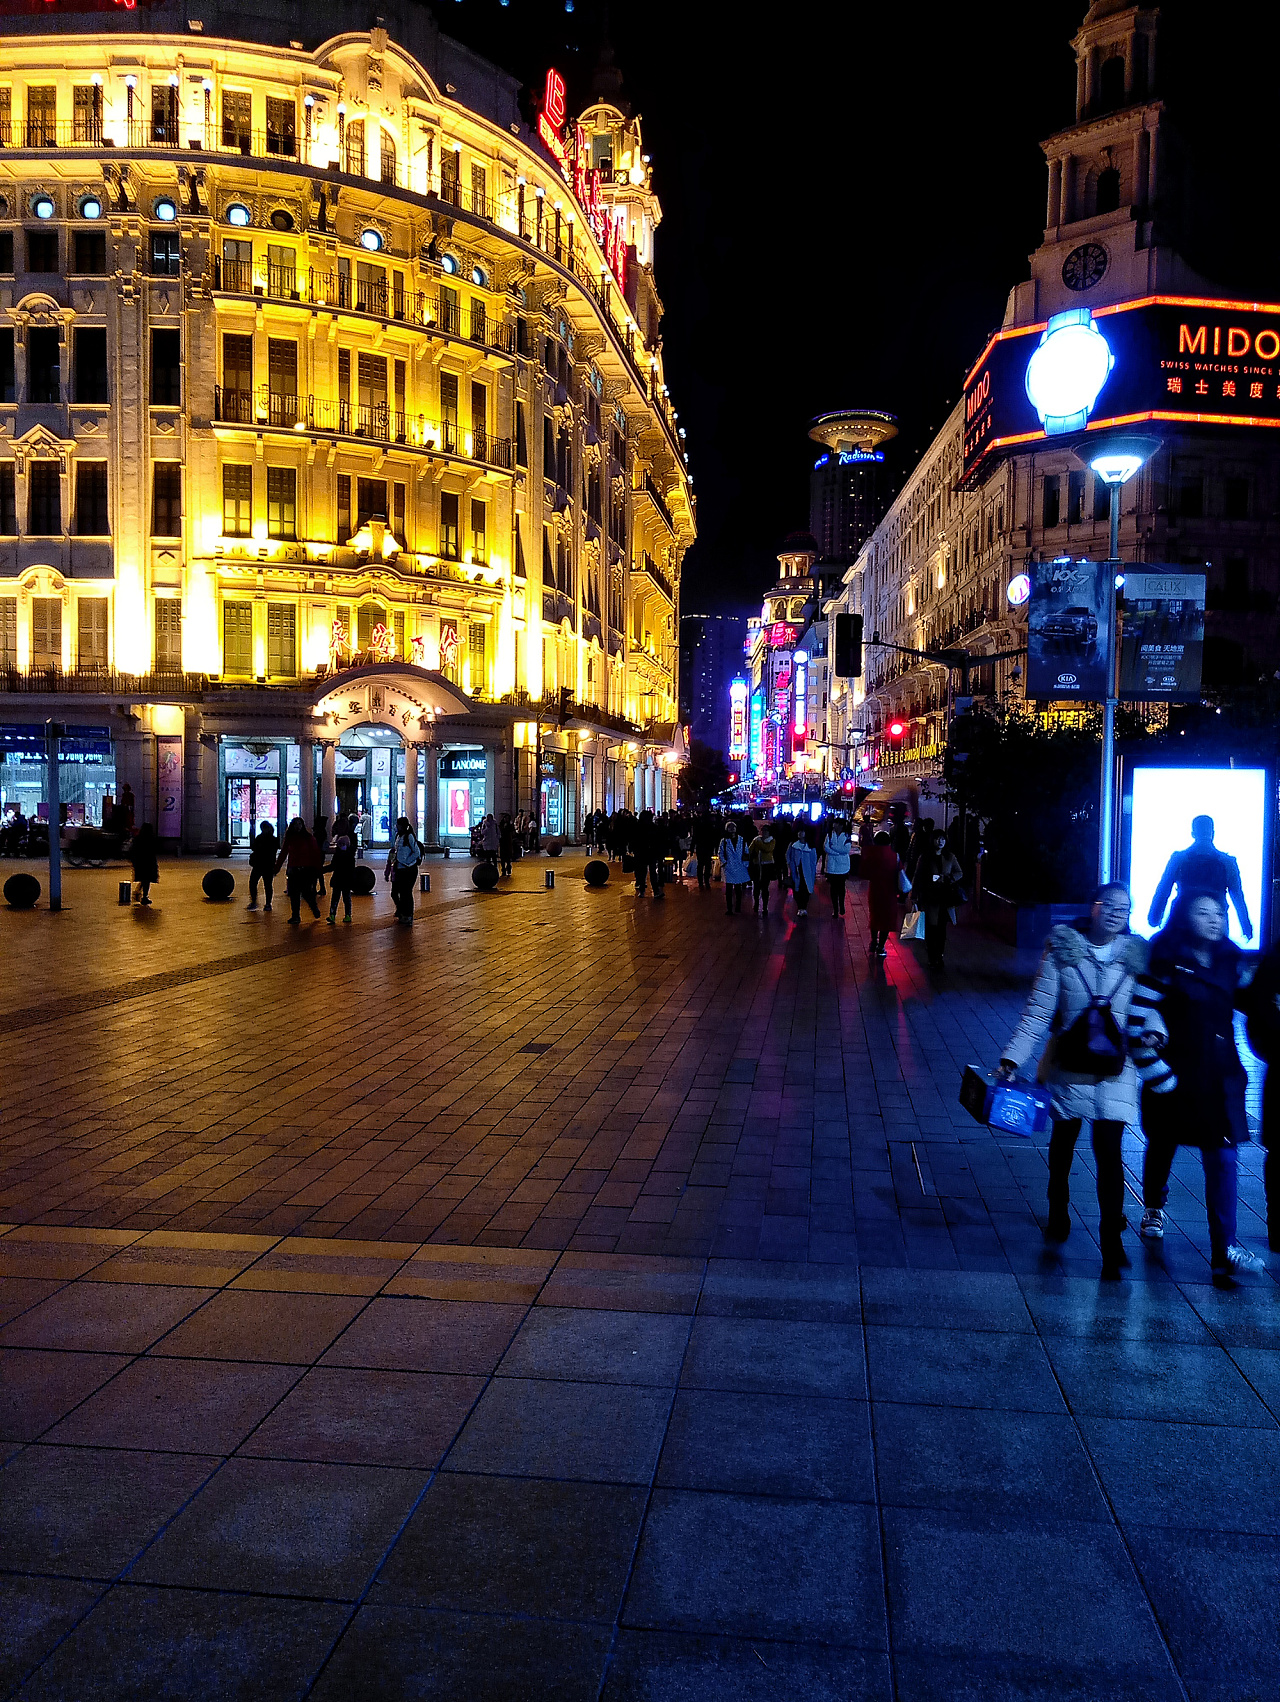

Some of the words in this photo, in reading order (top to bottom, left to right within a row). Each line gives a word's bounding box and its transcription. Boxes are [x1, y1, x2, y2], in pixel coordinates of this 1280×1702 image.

[1179, 324, 1280, 360] MIDO
[1160, 360, 1190, 370] SWISS
[1194, 362, 1239, 373] WATCHES
[1243, 365, 1273, 375] SINCE
[1167, 377, 1280, 399] 瑞士美度
[967, 371, 990, 422] MIDO
[377, 760, 385, 771] 2
[451, 758, 487, 770] LANCÔME
[162, 796, 176, 812] 2
